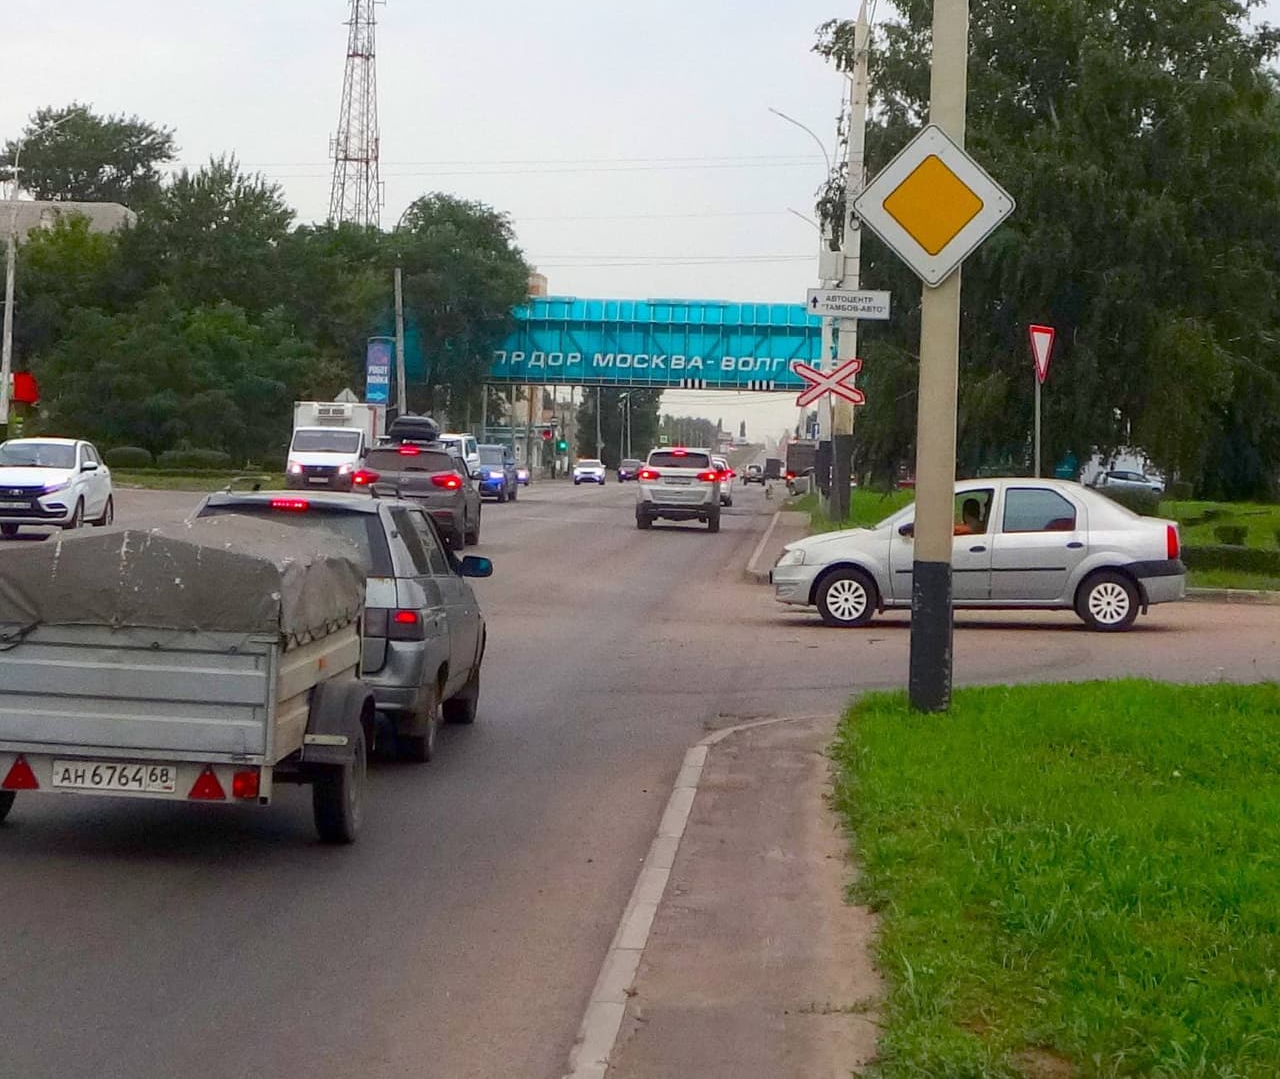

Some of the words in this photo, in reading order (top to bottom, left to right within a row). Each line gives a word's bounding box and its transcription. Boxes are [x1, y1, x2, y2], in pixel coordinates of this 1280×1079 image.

[825, 295, 874, 303] АВТОЦЕНТР
[91, 765, 143, 788] 6764
[148, 767, 169, 783] 68
